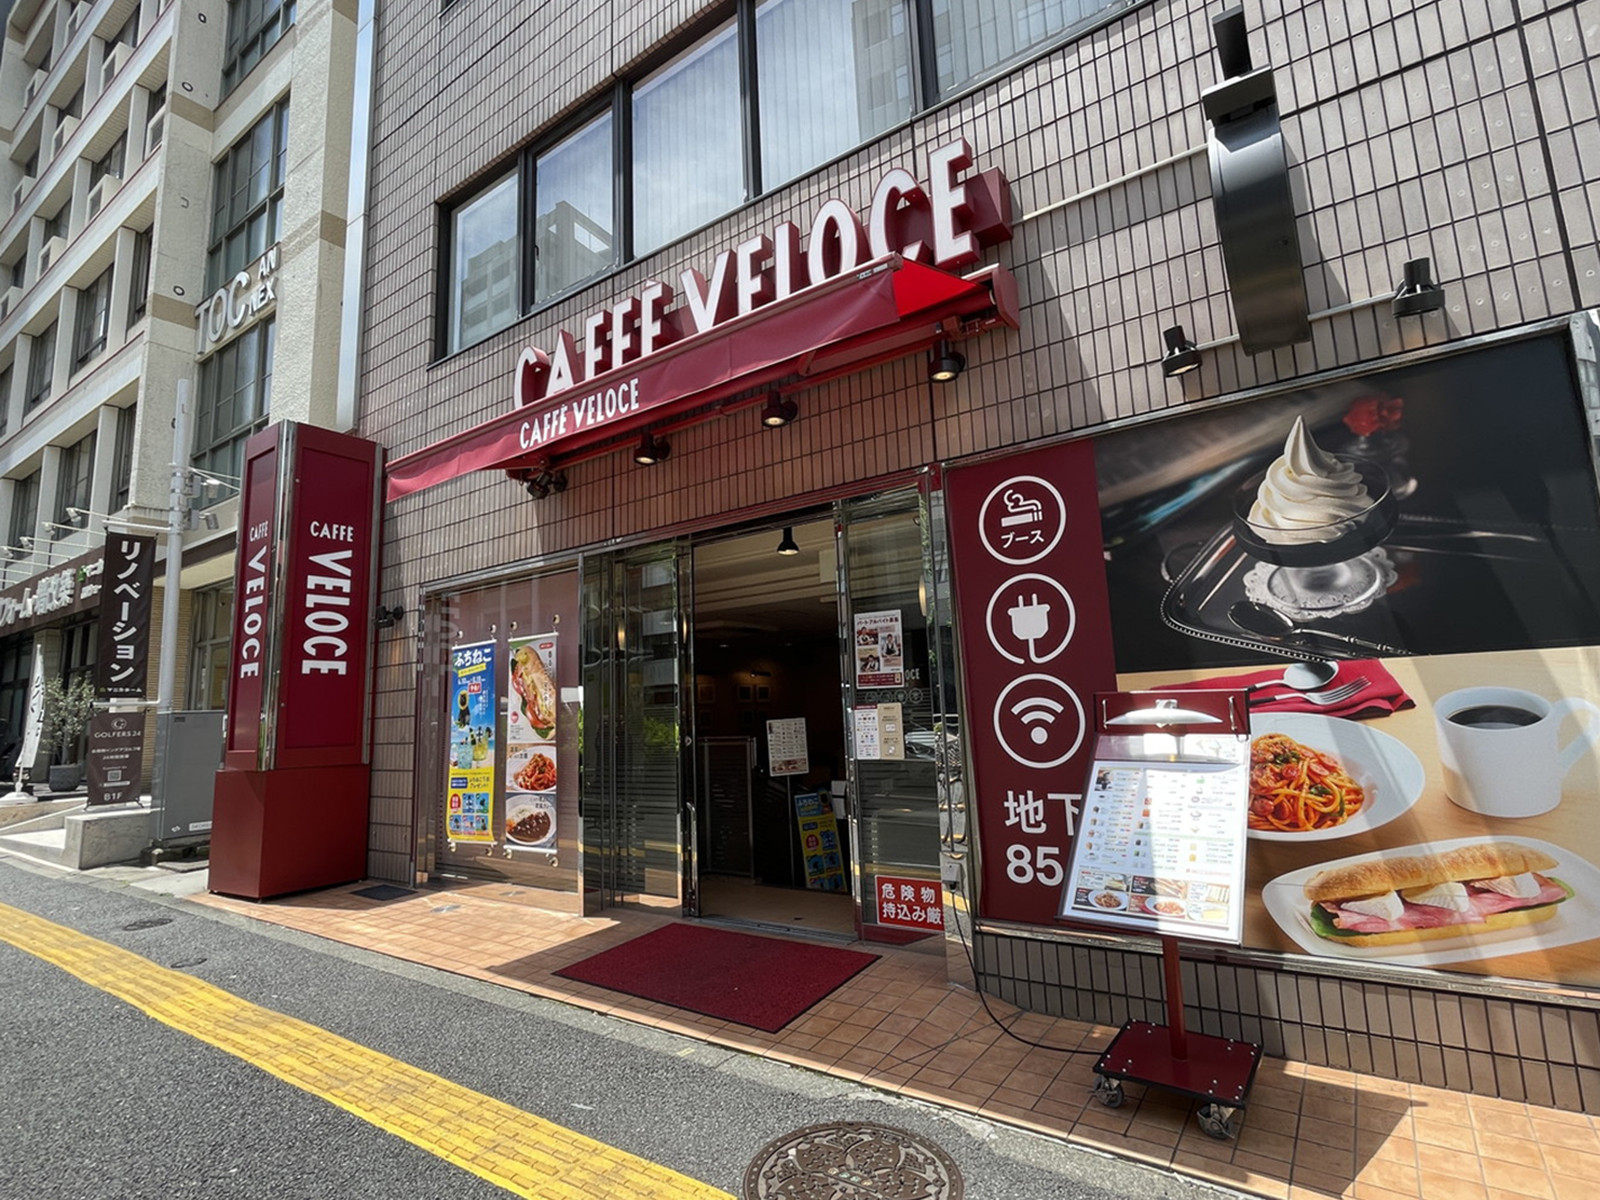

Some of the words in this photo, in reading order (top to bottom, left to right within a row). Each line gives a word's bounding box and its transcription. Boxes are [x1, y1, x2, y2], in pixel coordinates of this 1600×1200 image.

[680, 137, 973, 333] VELOCE
[258, 246, 280, 279] AN
[195, 271, 251, 354] TOC
[249, 278, 276, 316] NEX
[573, 378, 639, 428] VELOCE
[1001, 530, 1045, 548] ブース
[110, 541, 141, 682] リノベーション
[240, 545, 267, 679] VELOCE
[302, 550, 352, 675] VELOCE
[454, 648, 492, 667] ふちねこ
[1003, 789, 1082, 836] 地下
[1006, 843, 1064, 887] 85
[881, 882, 936, 904] 危険物
[882, 902, 942, 925] 持込み厳
